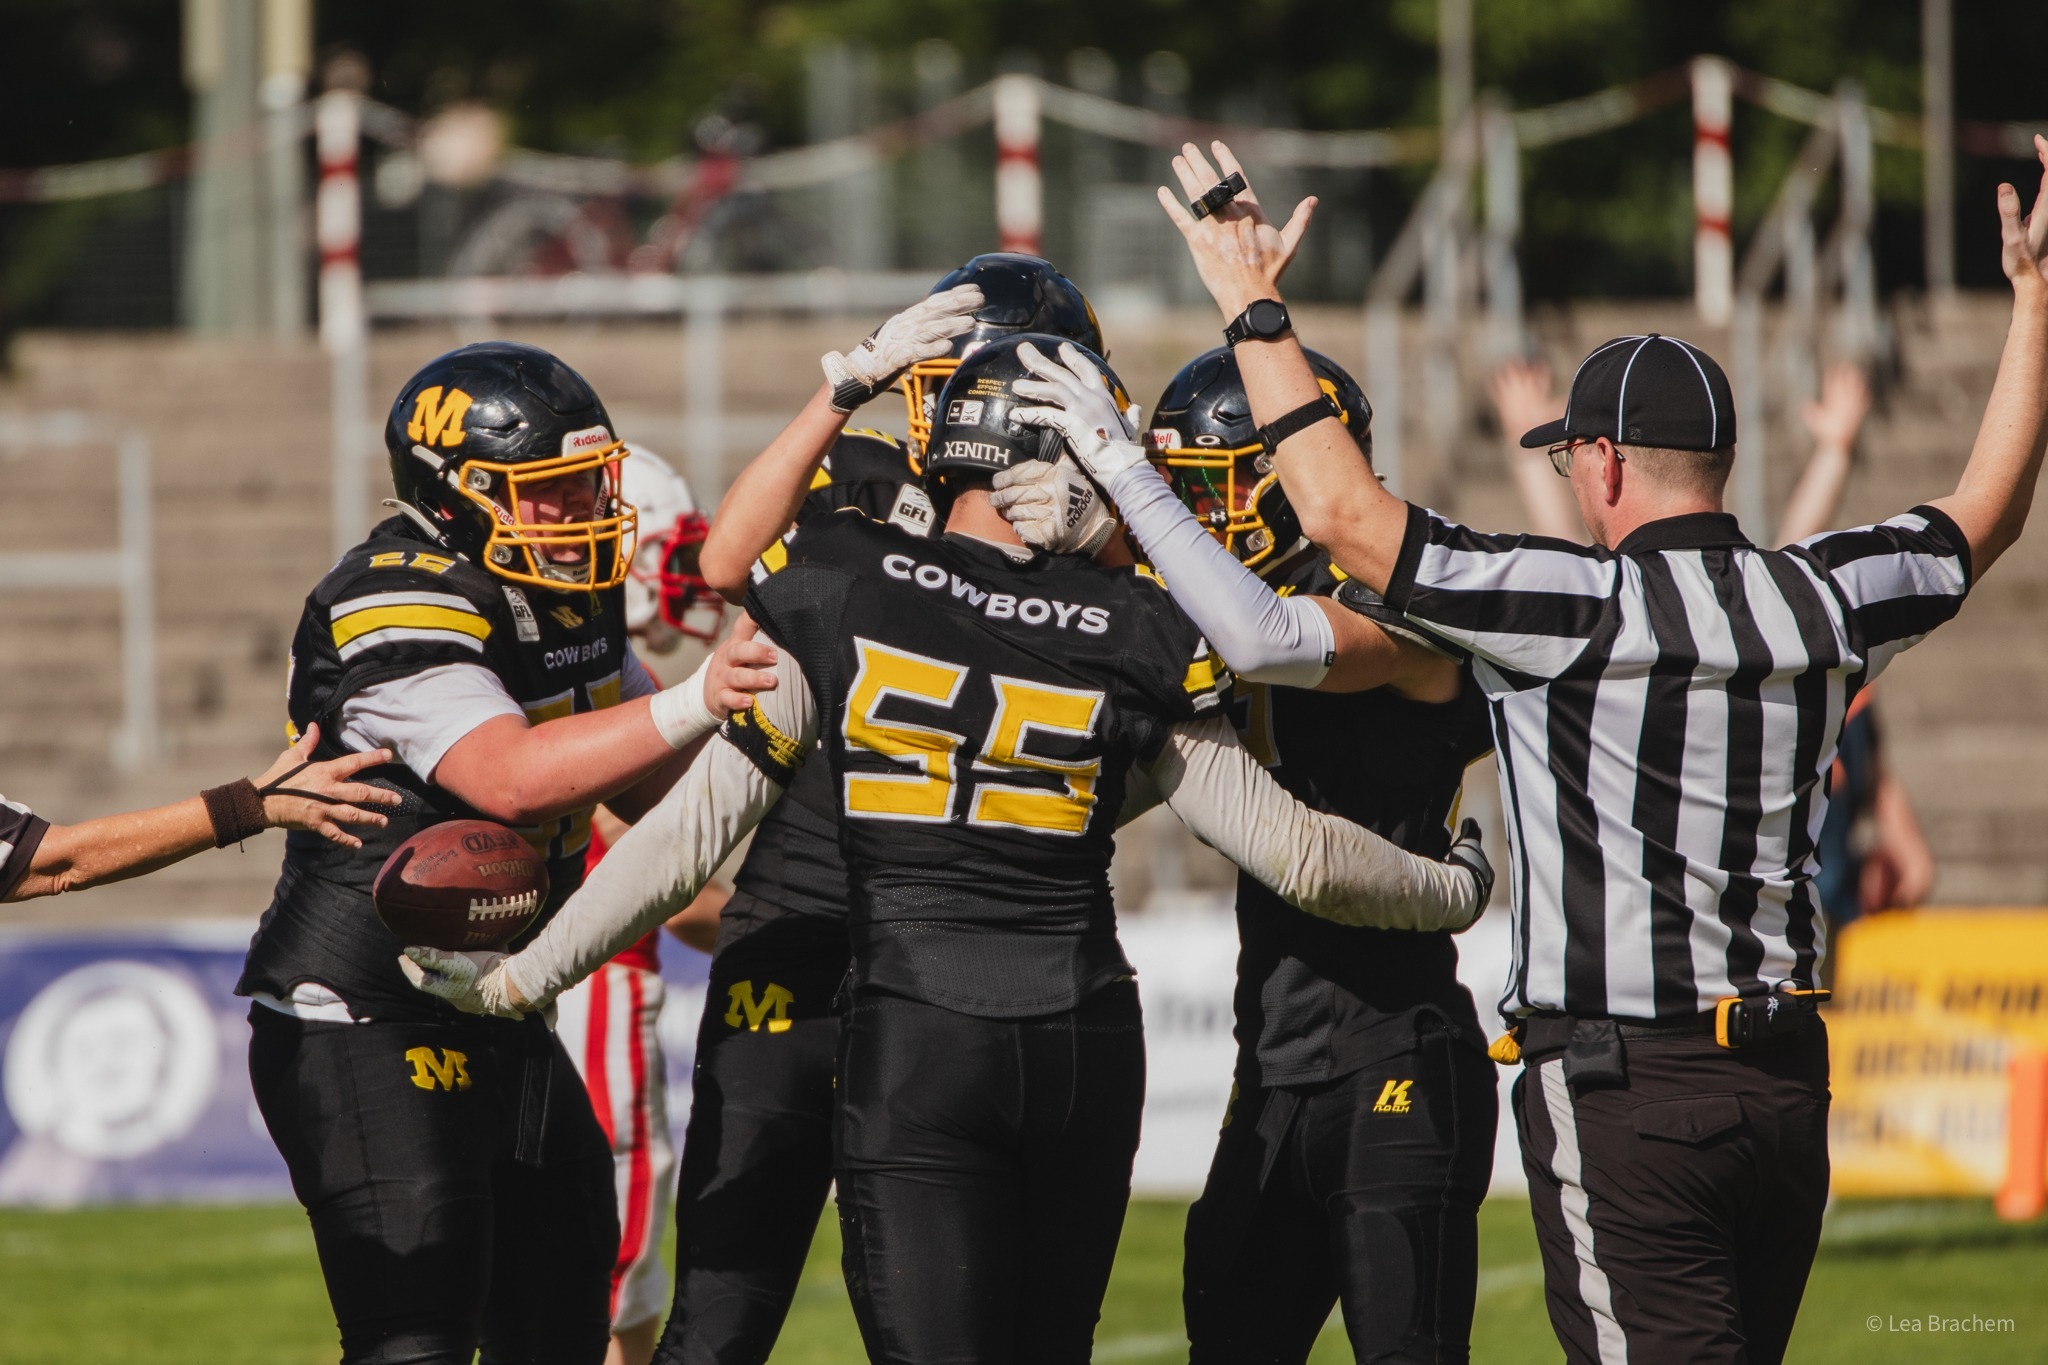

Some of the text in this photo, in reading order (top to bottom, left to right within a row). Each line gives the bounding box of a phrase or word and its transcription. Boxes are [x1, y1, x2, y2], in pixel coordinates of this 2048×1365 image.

[967, 389, 1010, 400] COMMITMENT
[976, 384, 1003, 392] EFFORT
[977, 378, 1007, 387] RESPECT
[407, 386, 474, 447] M
[943, 441, 1010, 465] XENITH
[898, 502, 928, 523] GFL
[1067, 488, 1093, 528] adidas
[882, 554, 1111, 634] COWBOYS
[513, 605, 532, 618] GFL
[841, 635, 1105, 836] 55
[724, 980, 794, 1033] M
[405, 1046, 472, 1091] M
